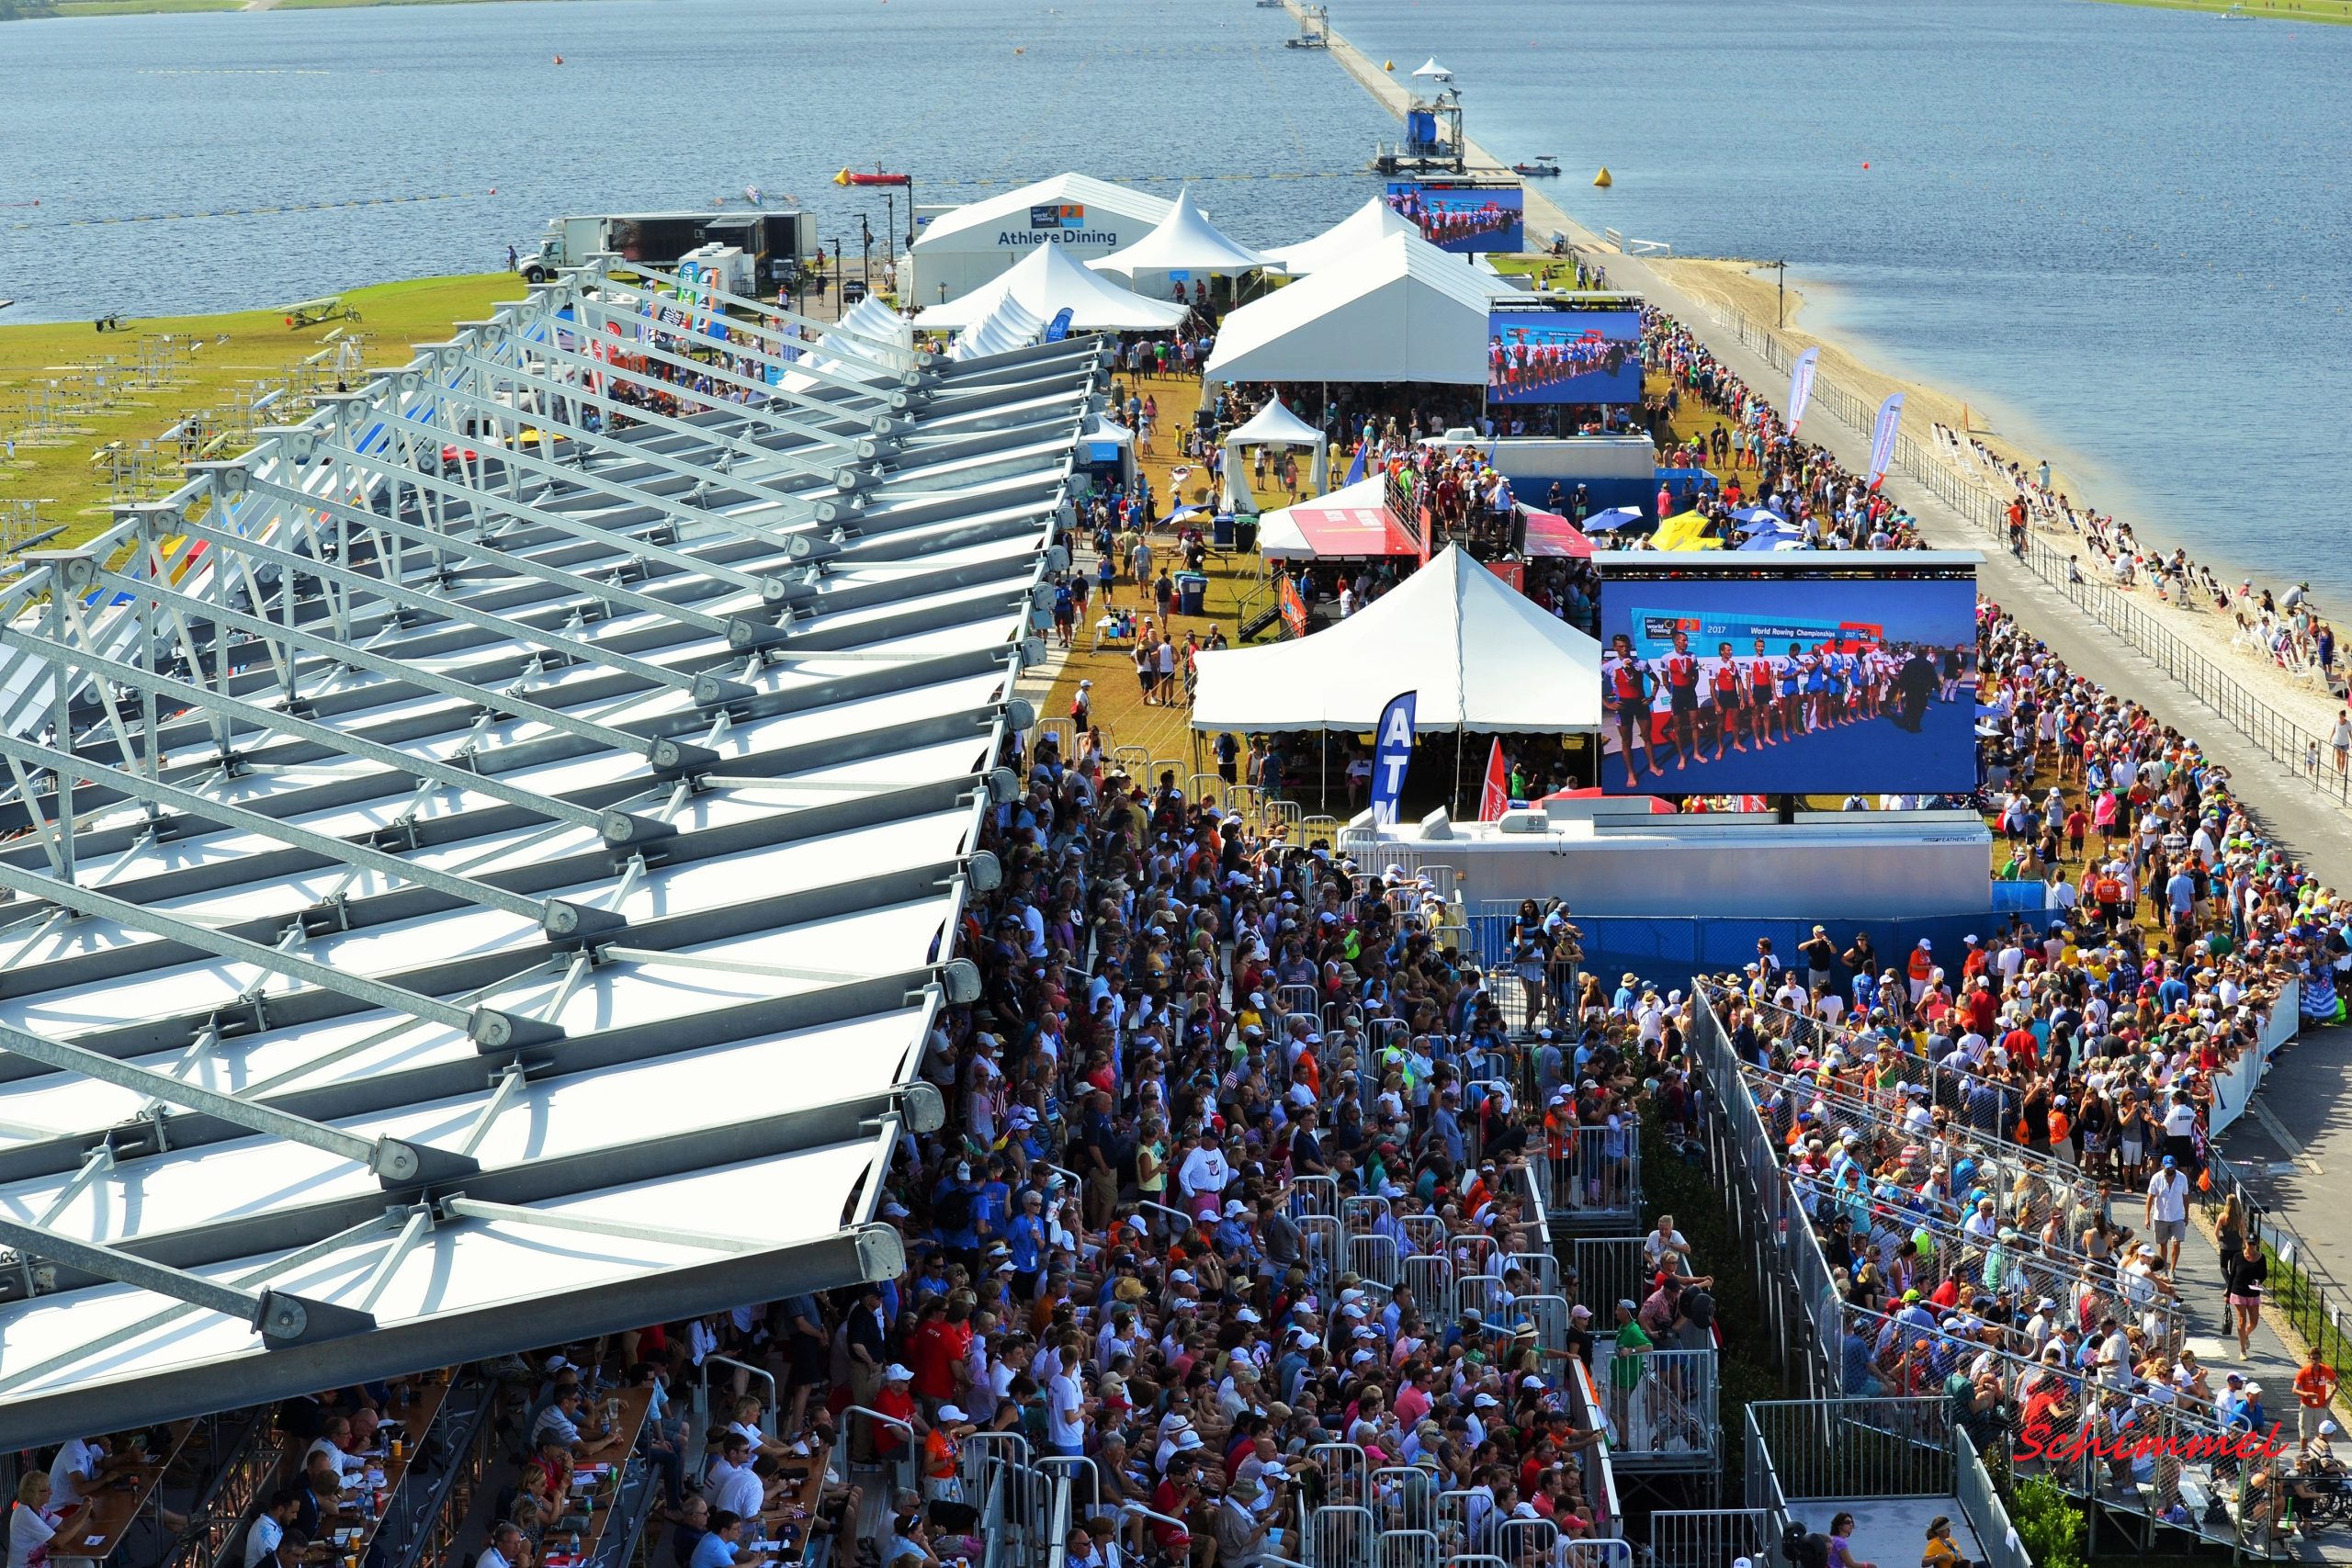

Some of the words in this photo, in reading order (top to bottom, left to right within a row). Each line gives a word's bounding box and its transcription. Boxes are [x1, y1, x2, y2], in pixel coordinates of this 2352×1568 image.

[999, 231, 1059, 245] Athlete
[1064, 230, 1116, 246] Dining
[1707, 626, 1726, 634] 2017
[1750, 626, 1771, 636] World
[1772, 627, 1794, 637] Rowing
[1796, 629, 1836, 638] Championships
